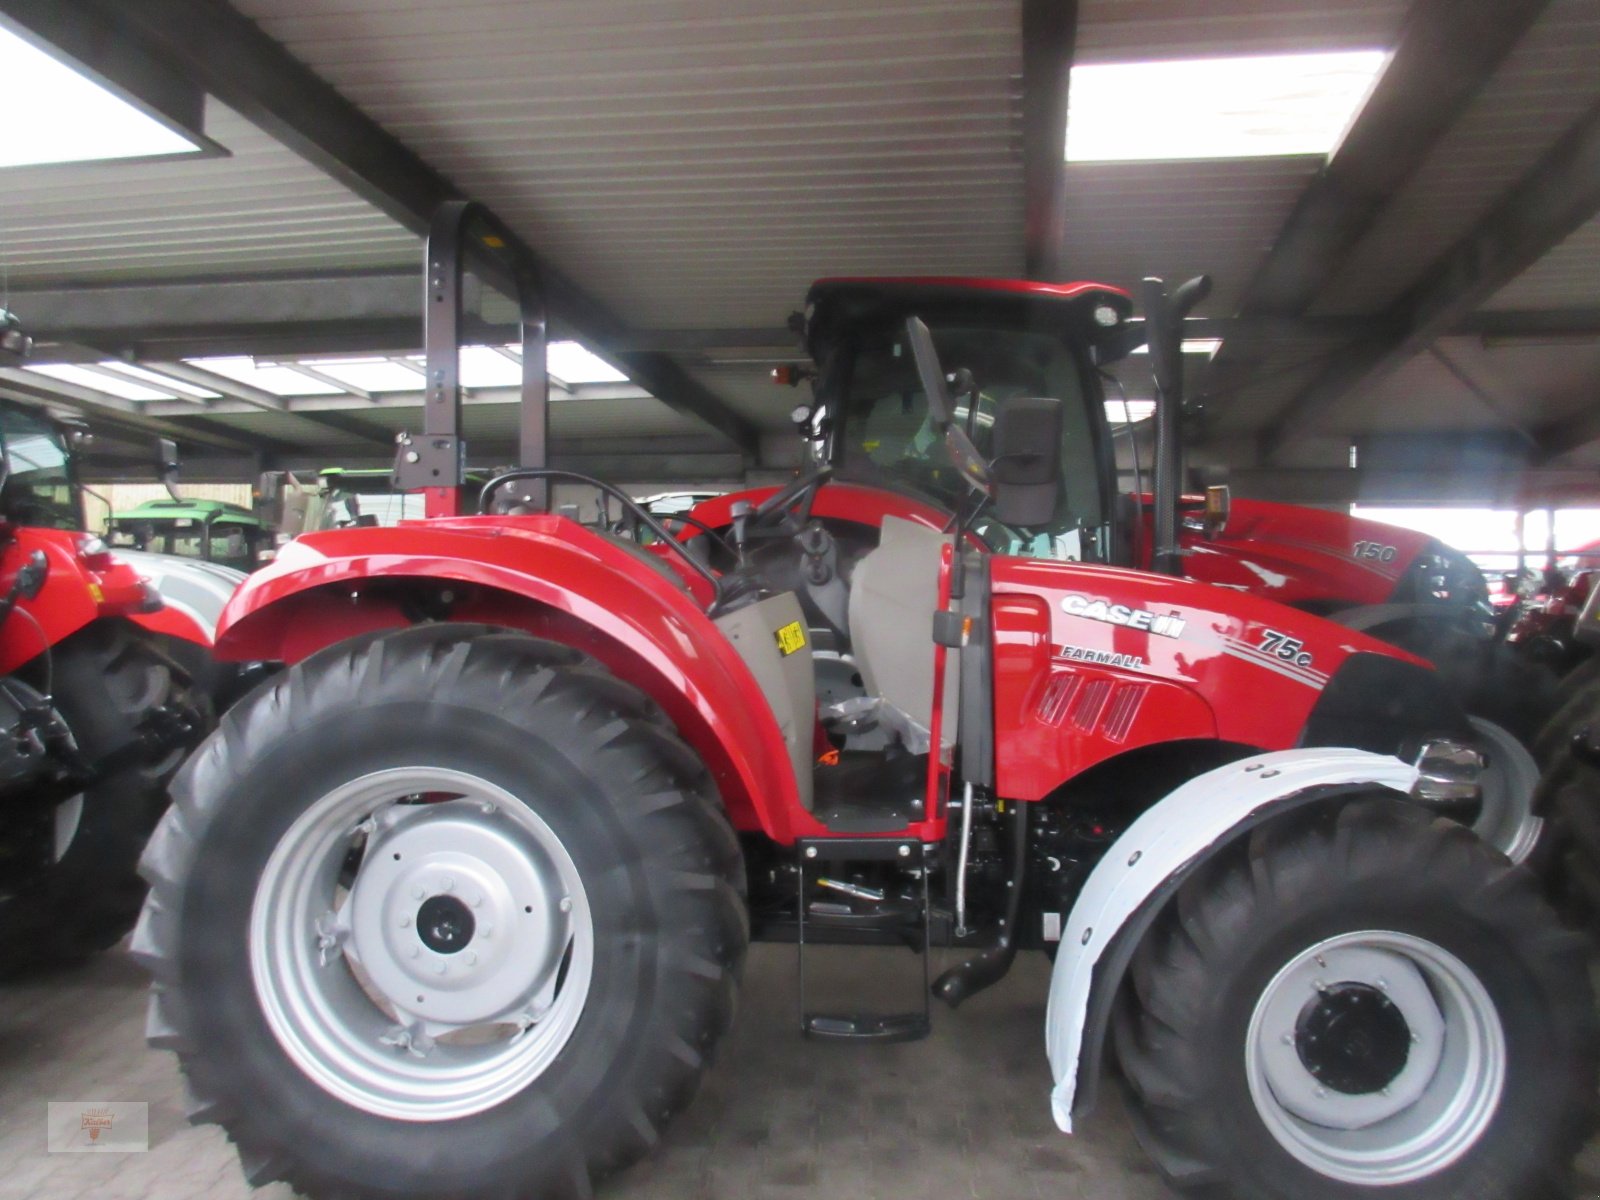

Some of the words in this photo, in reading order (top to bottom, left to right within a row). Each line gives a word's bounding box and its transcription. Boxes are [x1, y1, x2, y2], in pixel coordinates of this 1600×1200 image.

[1353, 541, 1397, 562] 150
[1061, 595, 1154, 631] CASE
[1061, 646, 1144, 669] FARMALL
